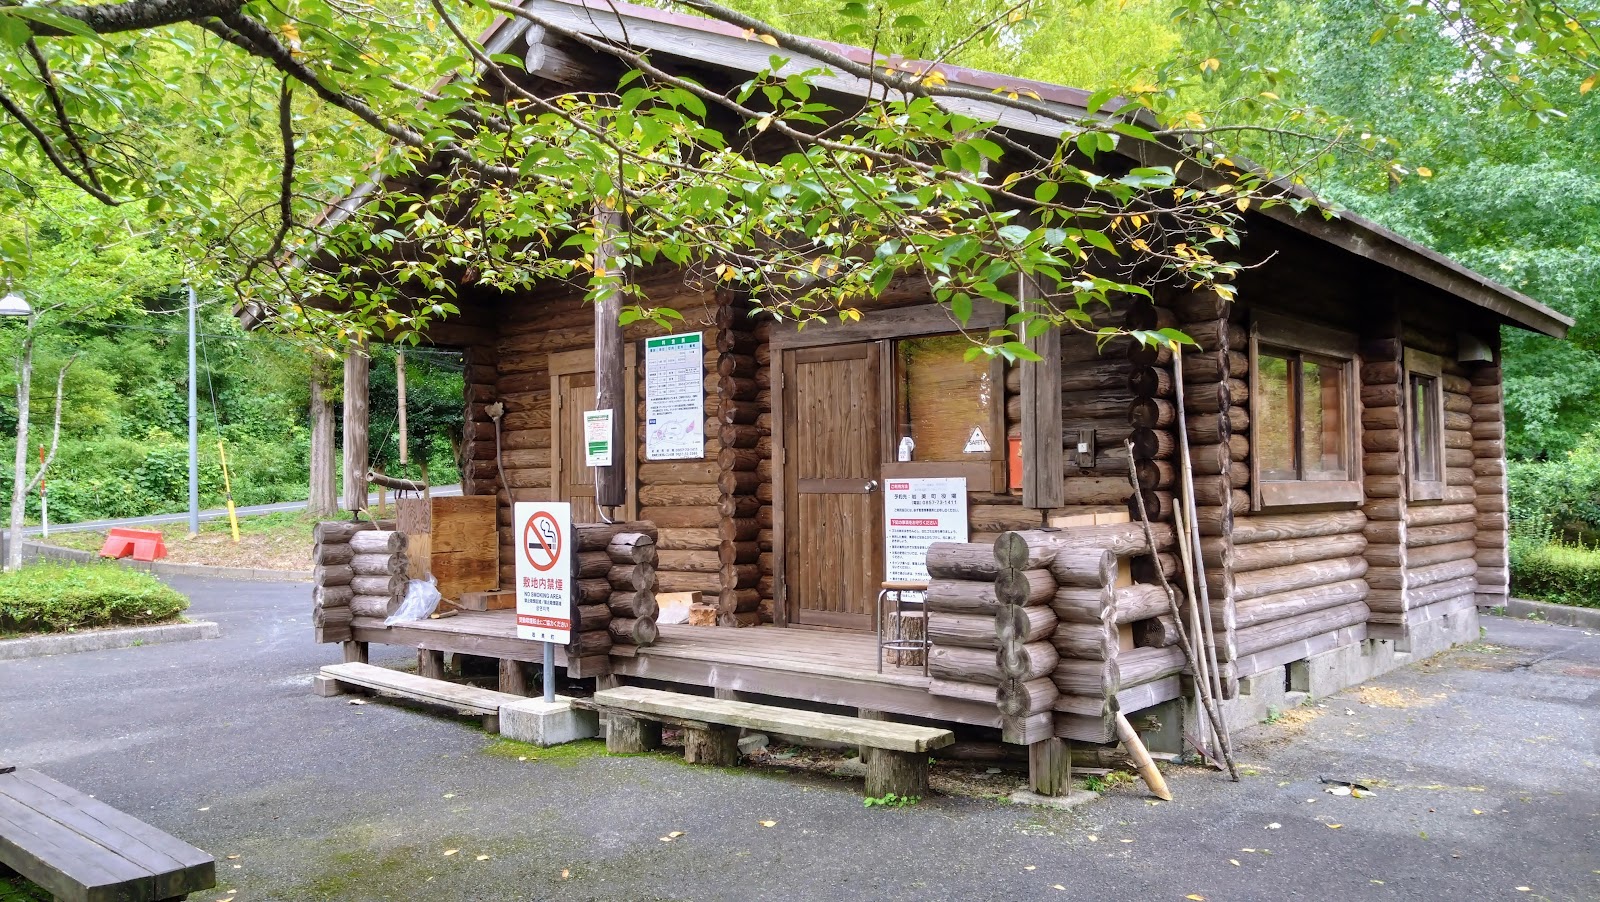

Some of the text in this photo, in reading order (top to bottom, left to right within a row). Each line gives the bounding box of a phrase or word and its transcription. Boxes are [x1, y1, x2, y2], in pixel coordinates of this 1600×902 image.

[523, 577, 563, 590] 敷地内禁煙
